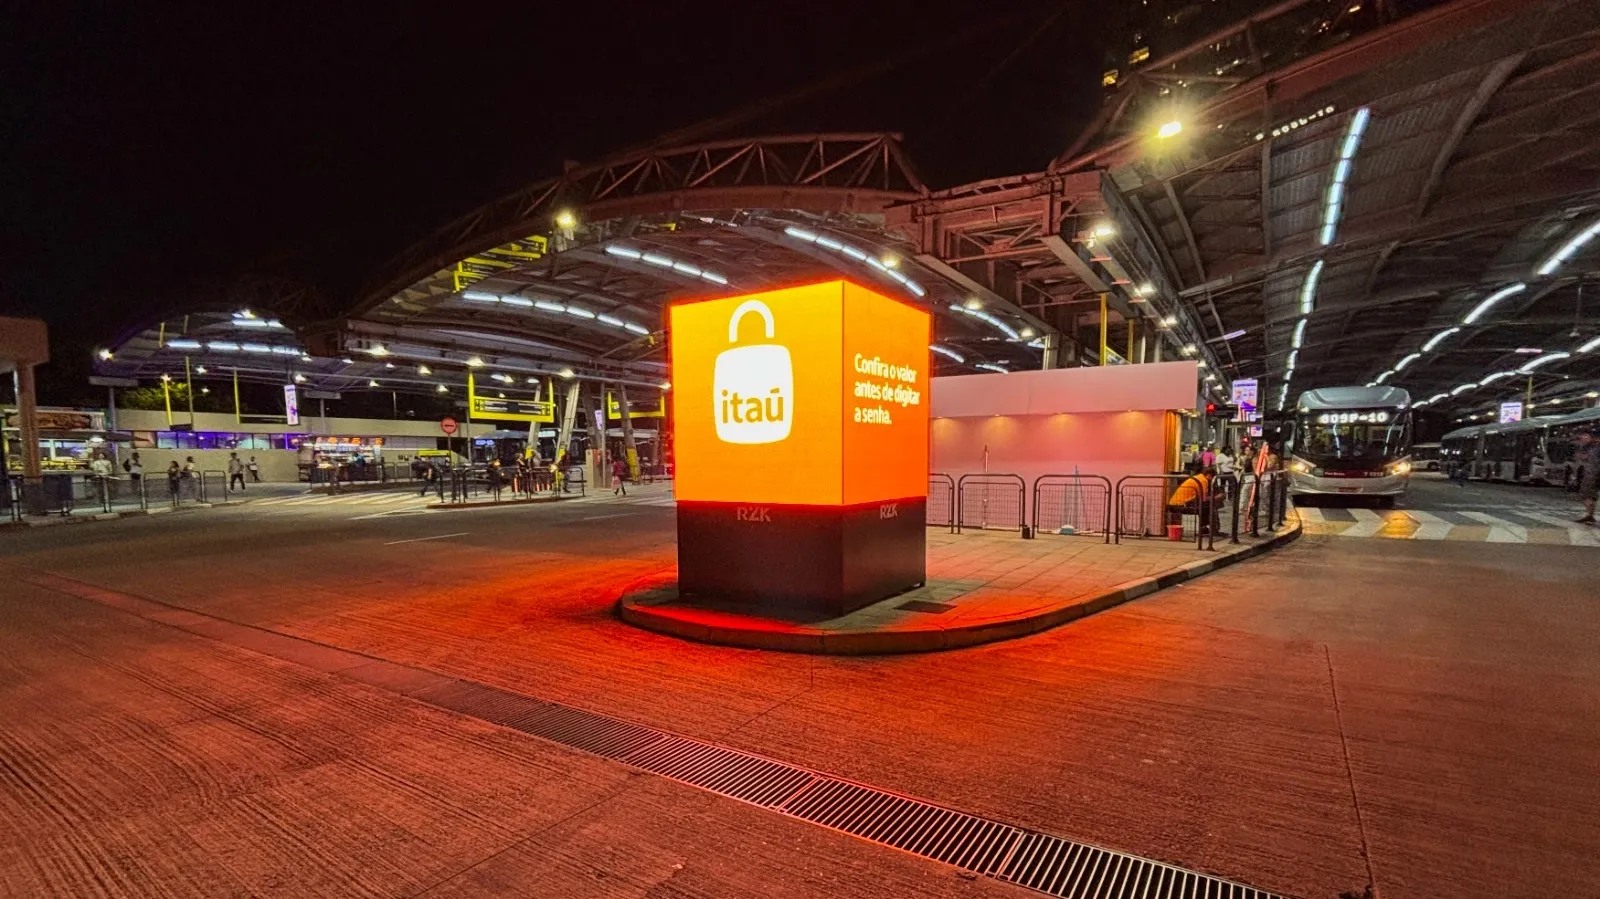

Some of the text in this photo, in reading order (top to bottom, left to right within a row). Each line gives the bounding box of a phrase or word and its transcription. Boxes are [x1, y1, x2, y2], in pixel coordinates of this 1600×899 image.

[854, 352, 917, 384] Confira o valor
[721, 387, 784, 424] itaú
[854, 380, 920, 407] antes de digitar
[854, 404, 893, 425] a senha.
[736, 506, 771, 522] RZK
[879, 503, 898, 519] RZK
